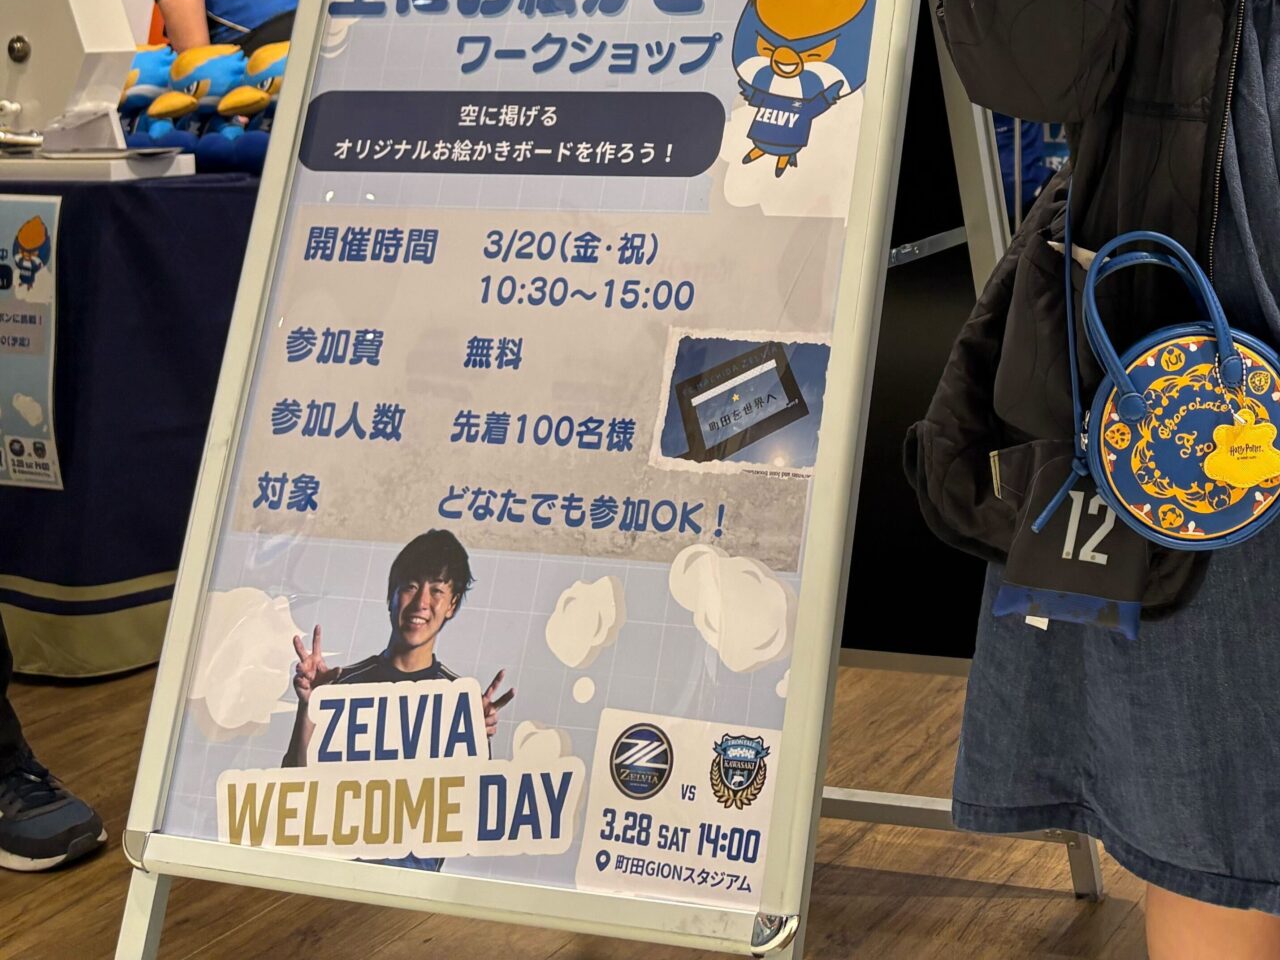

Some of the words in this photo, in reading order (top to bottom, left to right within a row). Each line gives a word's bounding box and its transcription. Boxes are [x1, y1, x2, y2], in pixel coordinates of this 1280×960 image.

[455, 30, 724, 76] ワークショップ
[458, 104, 559, 128] 空に掲げる
[755, 106, 801, 129] ZELVY
[303, 226, 440, 265] 開催時間
[285, 326, 385, 367] 参加費
[463, 335, 524, 371] 無料
[270, 398, 408, 442] 参加人数
[449, 409, 638, 453] 先着100名様
[708, 393, 778, 432] 町田を世界へ
[1230, 444, 1245, 456] Harry
[252, 472, 321, 513] 対象
[1062, 490, 1117, 566] 12
[316, 692, 479, 764] ZELVIA
[619, 768, 660, 785] ZELVIA
[681, 783, 697, 801] VS
[225, 776, 467, 848] WELCOME
[476, 771, 574, 843] DAY
[600, 807, 653, 847] 3.28
[657, 824, 691, 853] SAT
[697, 822, 761, 864] 14:00
[615, 853, 752, 893] 町田GIONスタジアム
